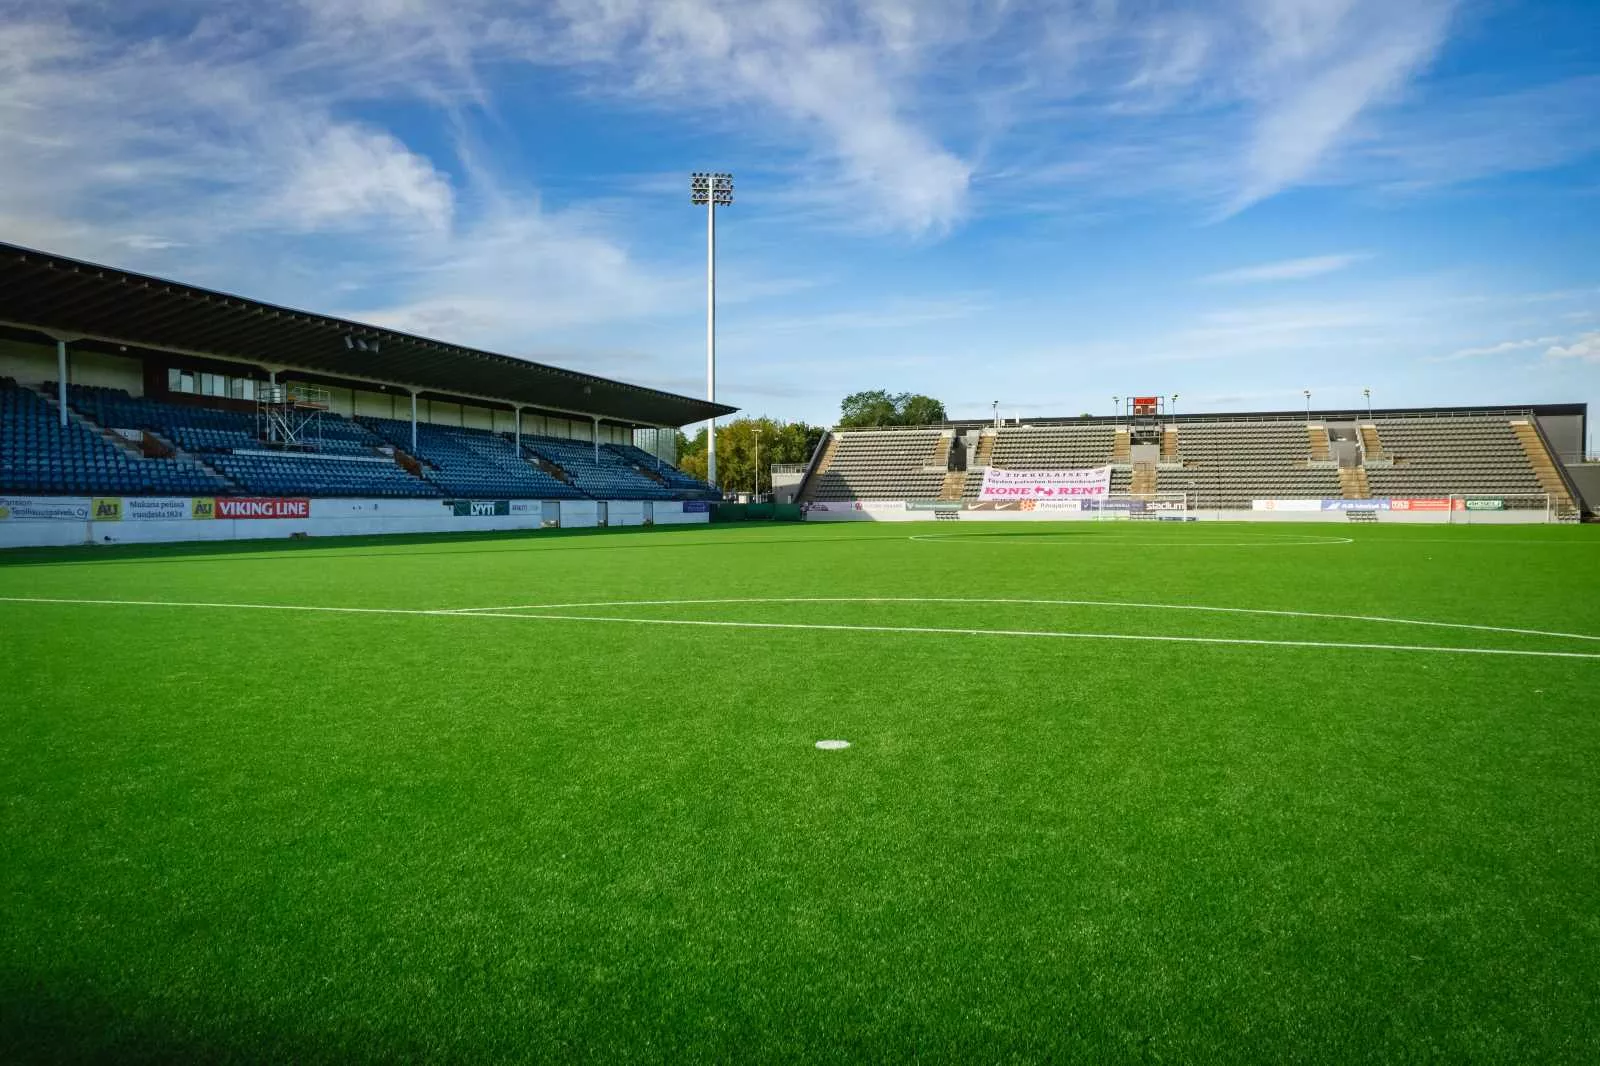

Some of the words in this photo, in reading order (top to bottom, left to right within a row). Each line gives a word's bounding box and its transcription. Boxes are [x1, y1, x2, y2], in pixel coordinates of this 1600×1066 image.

[984, 487, 1032, 495] KONE
[1058, 486, 1106, 495] RENT
[219, 502, 273, 515] VIKING
[275, 502, 307, 515] LINE
[1145, 501, 1185, 510] stadium
